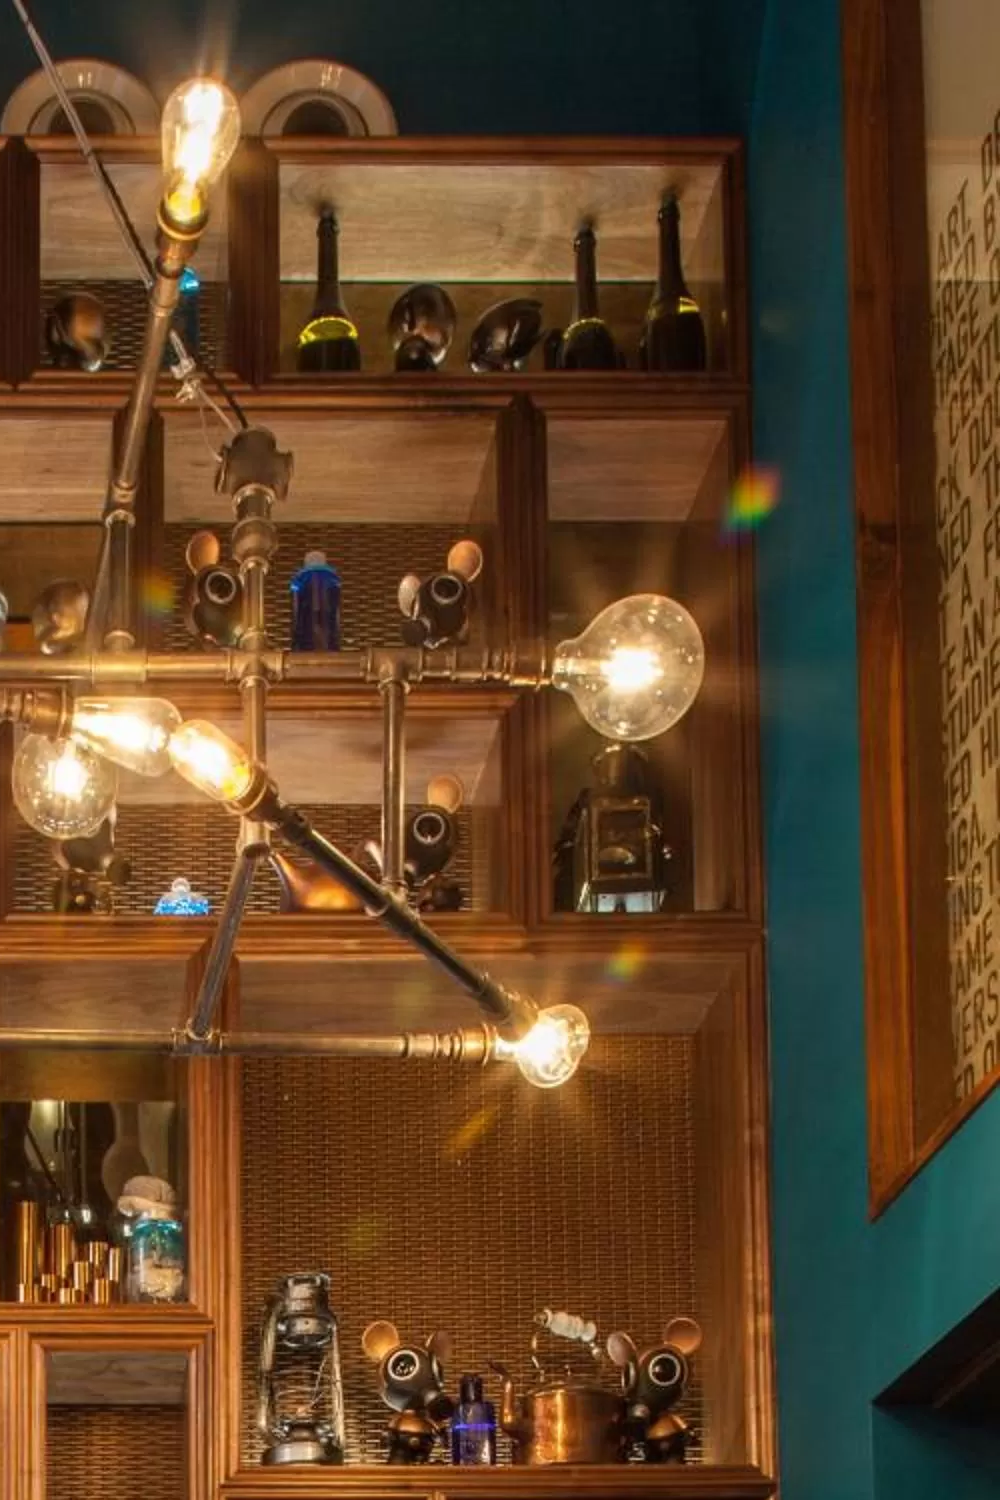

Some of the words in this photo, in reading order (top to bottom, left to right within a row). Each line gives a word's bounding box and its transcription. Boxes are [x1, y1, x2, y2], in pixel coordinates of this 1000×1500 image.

[937, 177, 971, 273] ART.
[960, 562, 973, 619] A
[961, 598, 985, 681] AN
